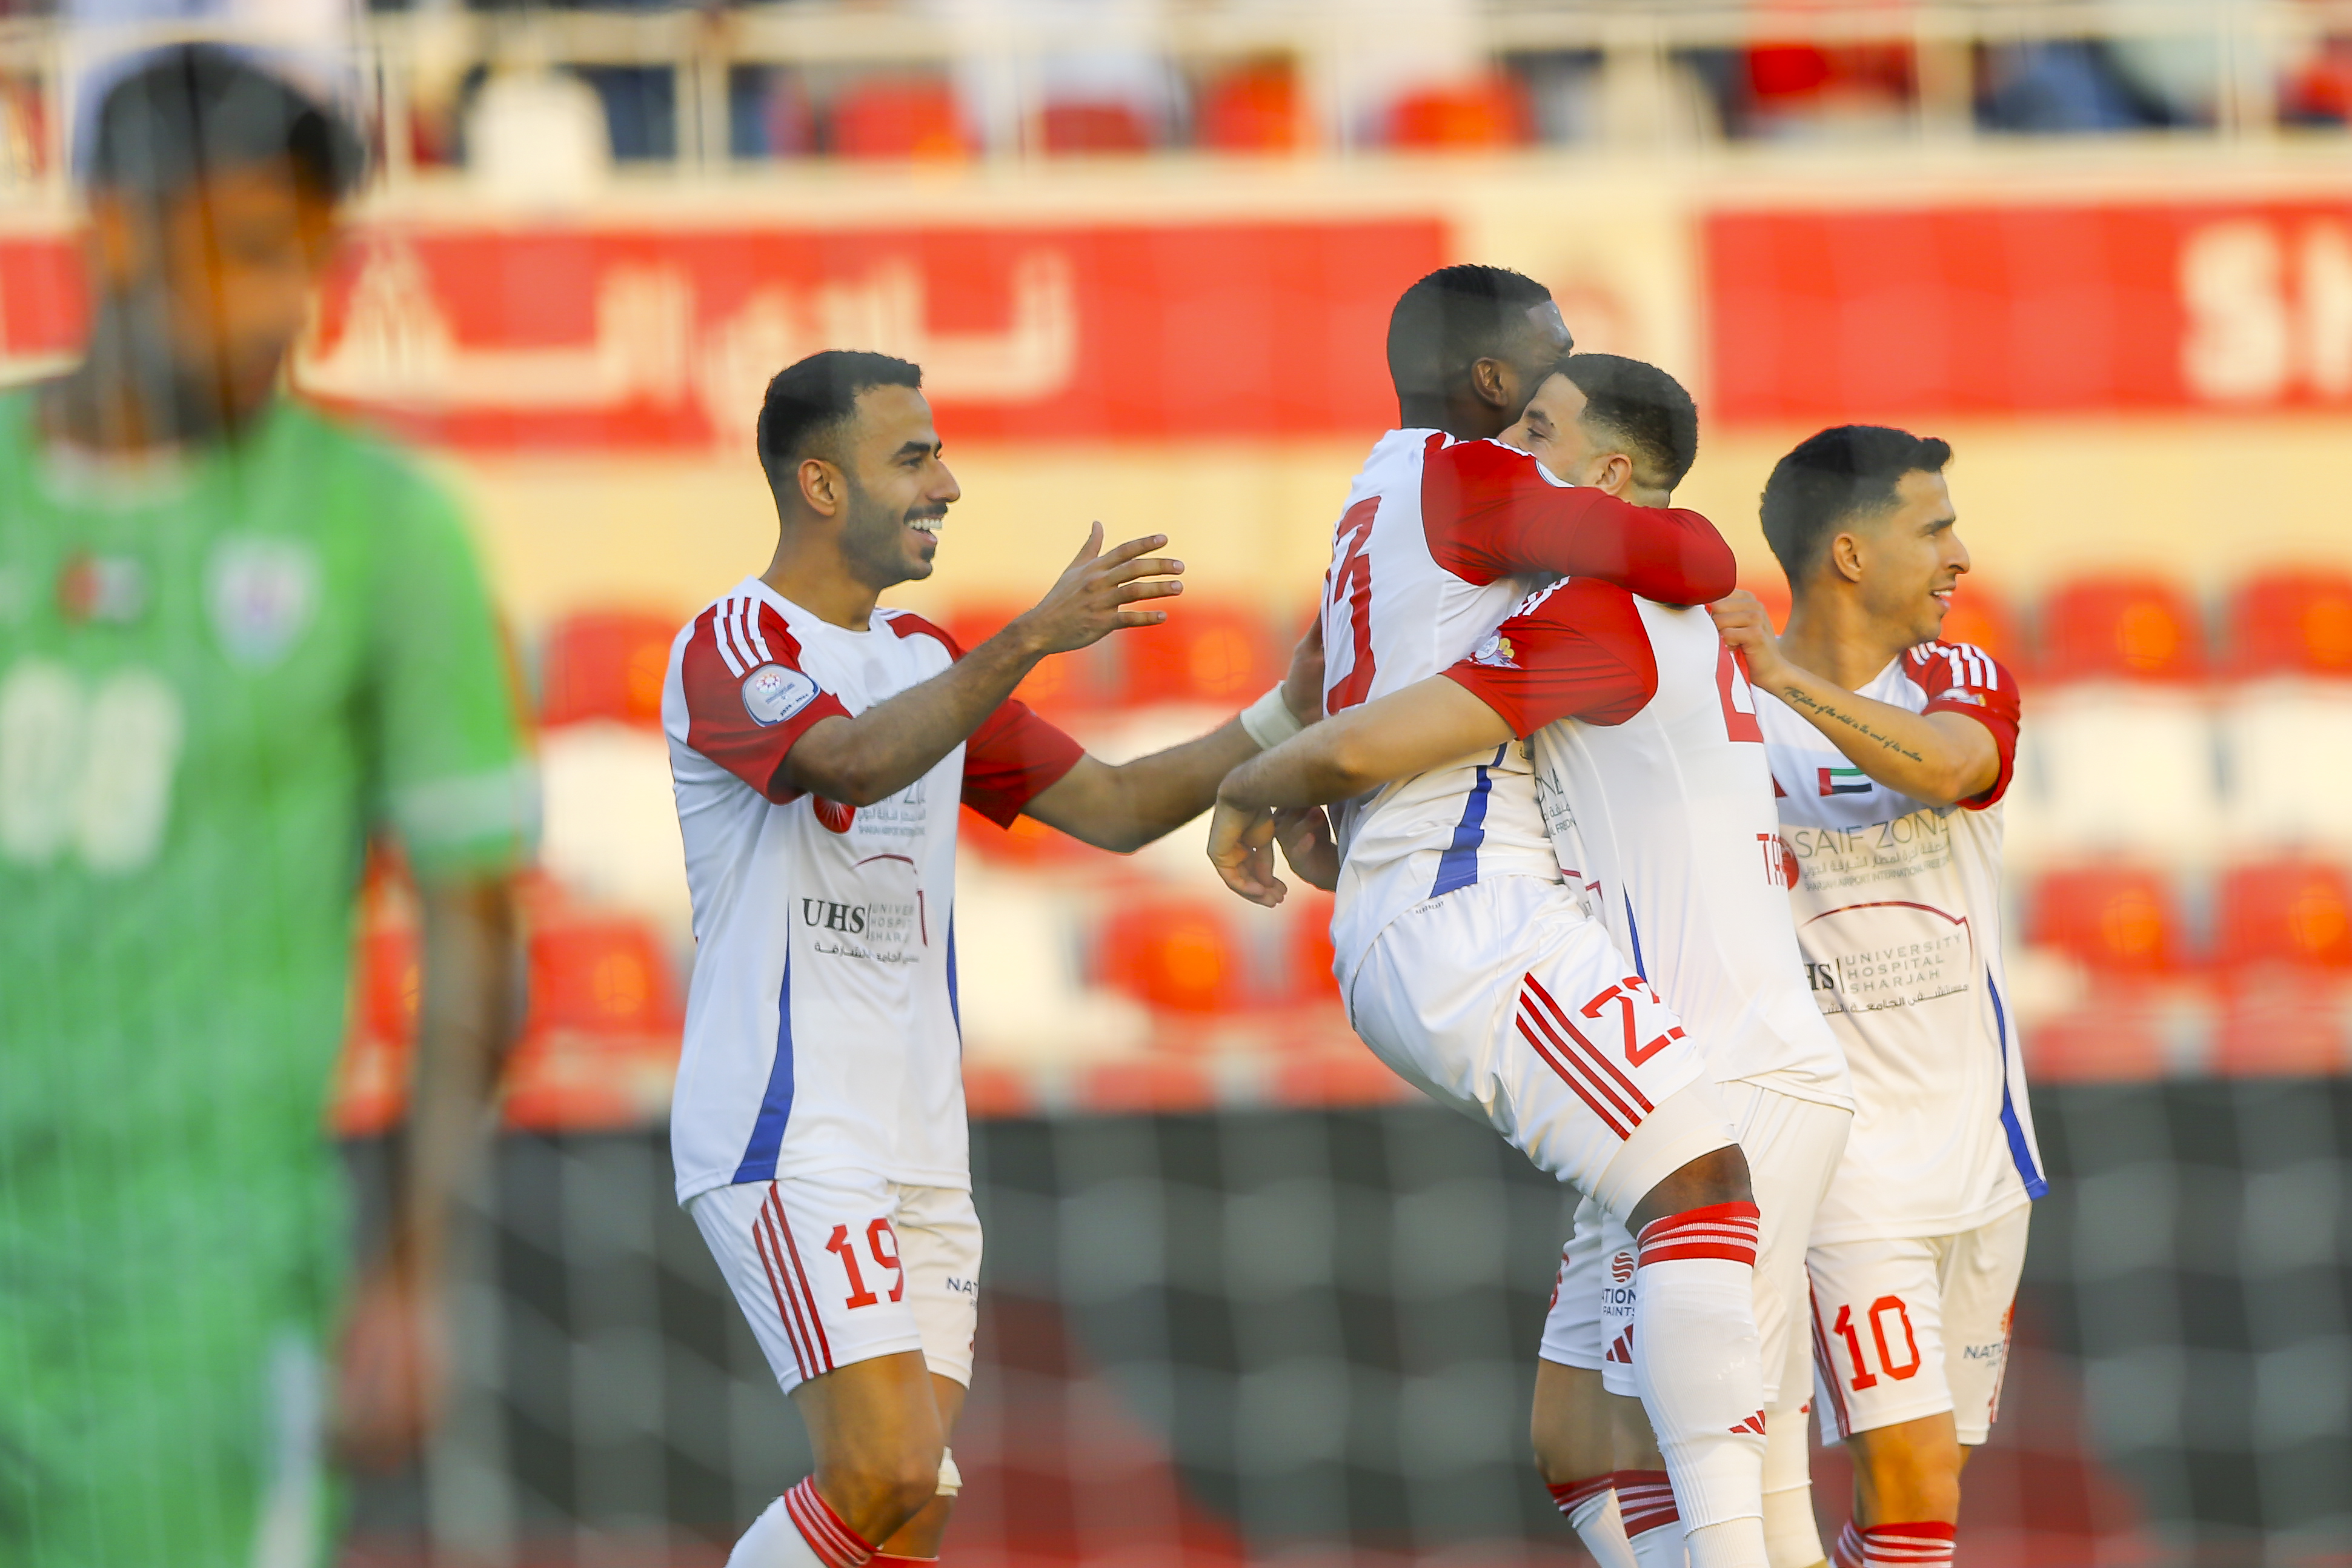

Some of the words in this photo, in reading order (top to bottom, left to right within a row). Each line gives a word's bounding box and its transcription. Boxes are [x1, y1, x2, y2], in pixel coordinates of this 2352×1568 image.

[1795, 825, 1864, 859] SAIF
[802, 898, 866, 934] UHS
[1845, 933, 1962, 965] UNIVERSITY
[1847, 953, 1945, 980] HOSPITAL
[1849, 969, 1940, 994] SHARJAH
[825, 1218, 904, 1310] 19
[1832, 1294, 1921, 1392] 10
